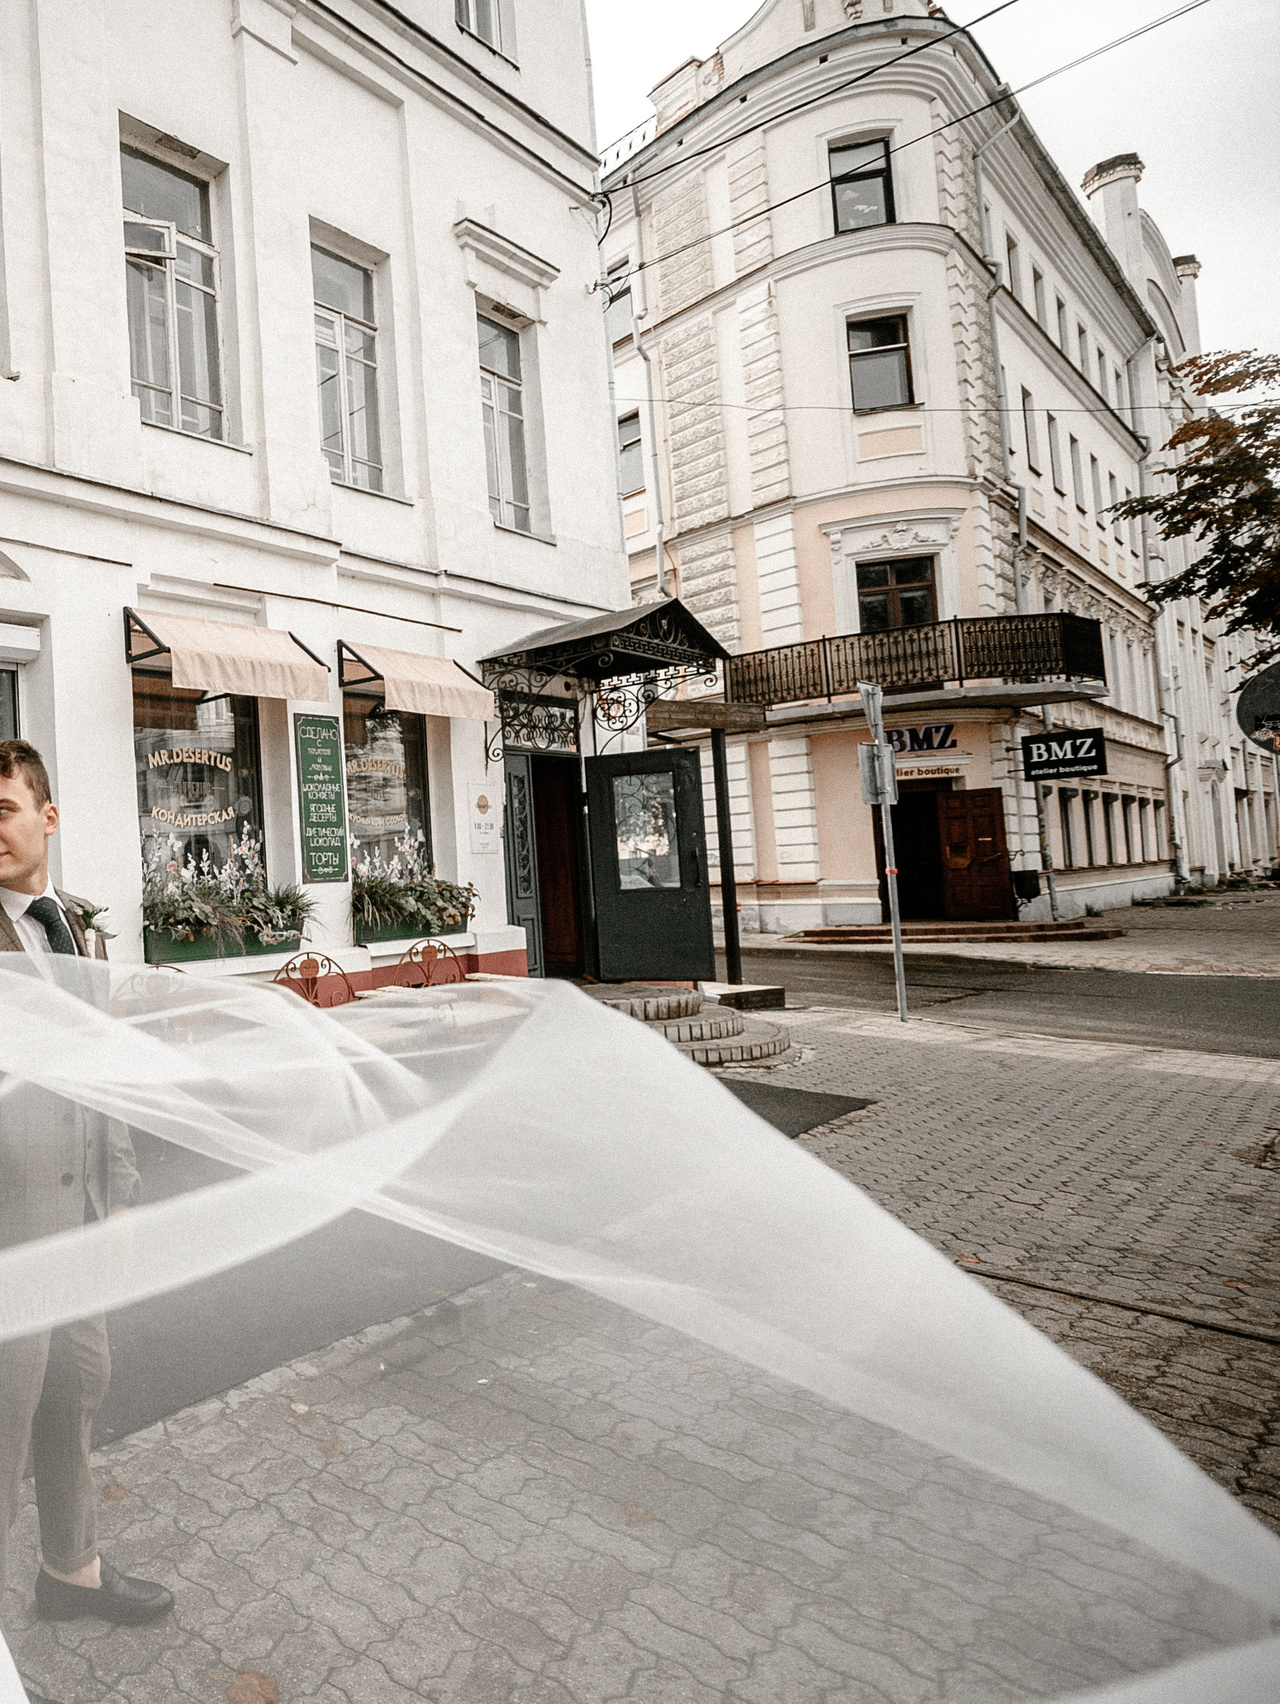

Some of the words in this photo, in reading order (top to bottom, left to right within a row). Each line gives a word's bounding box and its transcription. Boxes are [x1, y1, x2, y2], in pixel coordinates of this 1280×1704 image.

[300, 726, 339, 741] СДЕЛАНО
[883, 724, 957, 753] BMZ
[1029, 738, 1096, 762] BMZ
[917, 765, 960, 777] boutique
[1031, 767, 1058, 776] atelier
[1059, 764, 1098, 773] boutique
[151, 806, 235, 828] КОНДИТЕРСКАЯ
[309, 852, 339, 865] ТОРТЫ
